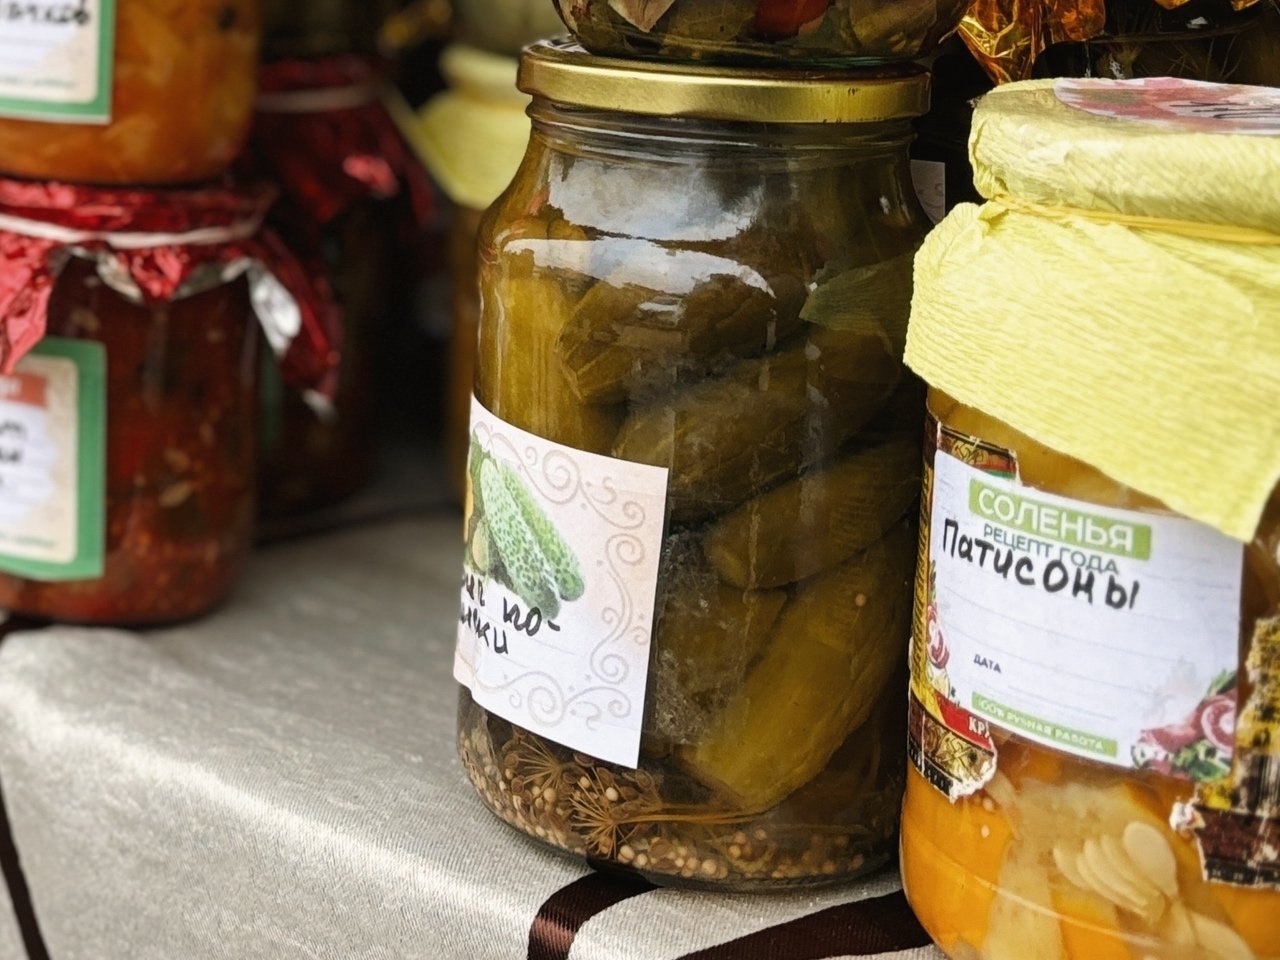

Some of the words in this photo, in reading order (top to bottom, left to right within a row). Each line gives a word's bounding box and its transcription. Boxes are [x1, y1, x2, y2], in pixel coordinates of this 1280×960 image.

[977, 488, 1134, 553] СОЛЕНЬЯ
[983, 523, 1055, 557] РЕЦЕПТ
[1059, 547, 1120, 575] ГОДА
[973, 653, 1002, 674] ДАТА
[1054, 729, 1104, 751] РАБОТА
